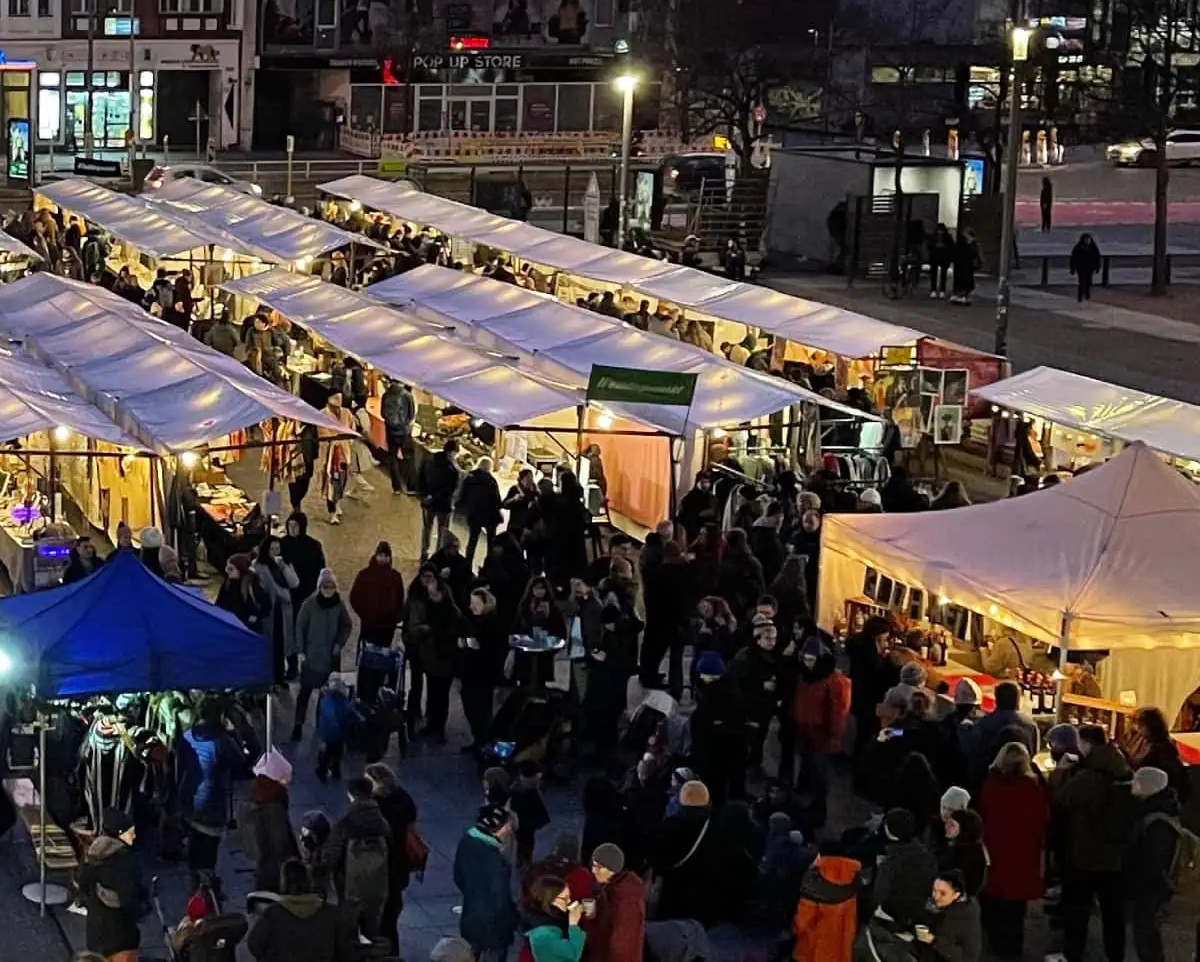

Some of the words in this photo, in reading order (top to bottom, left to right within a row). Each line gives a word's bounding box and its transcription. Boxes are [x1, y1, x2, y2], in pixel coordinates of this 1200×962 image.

[413, 55, 443, 69] POP
[449, 55, 469, 68] UP
[474, 55, 522, 68] STORE
